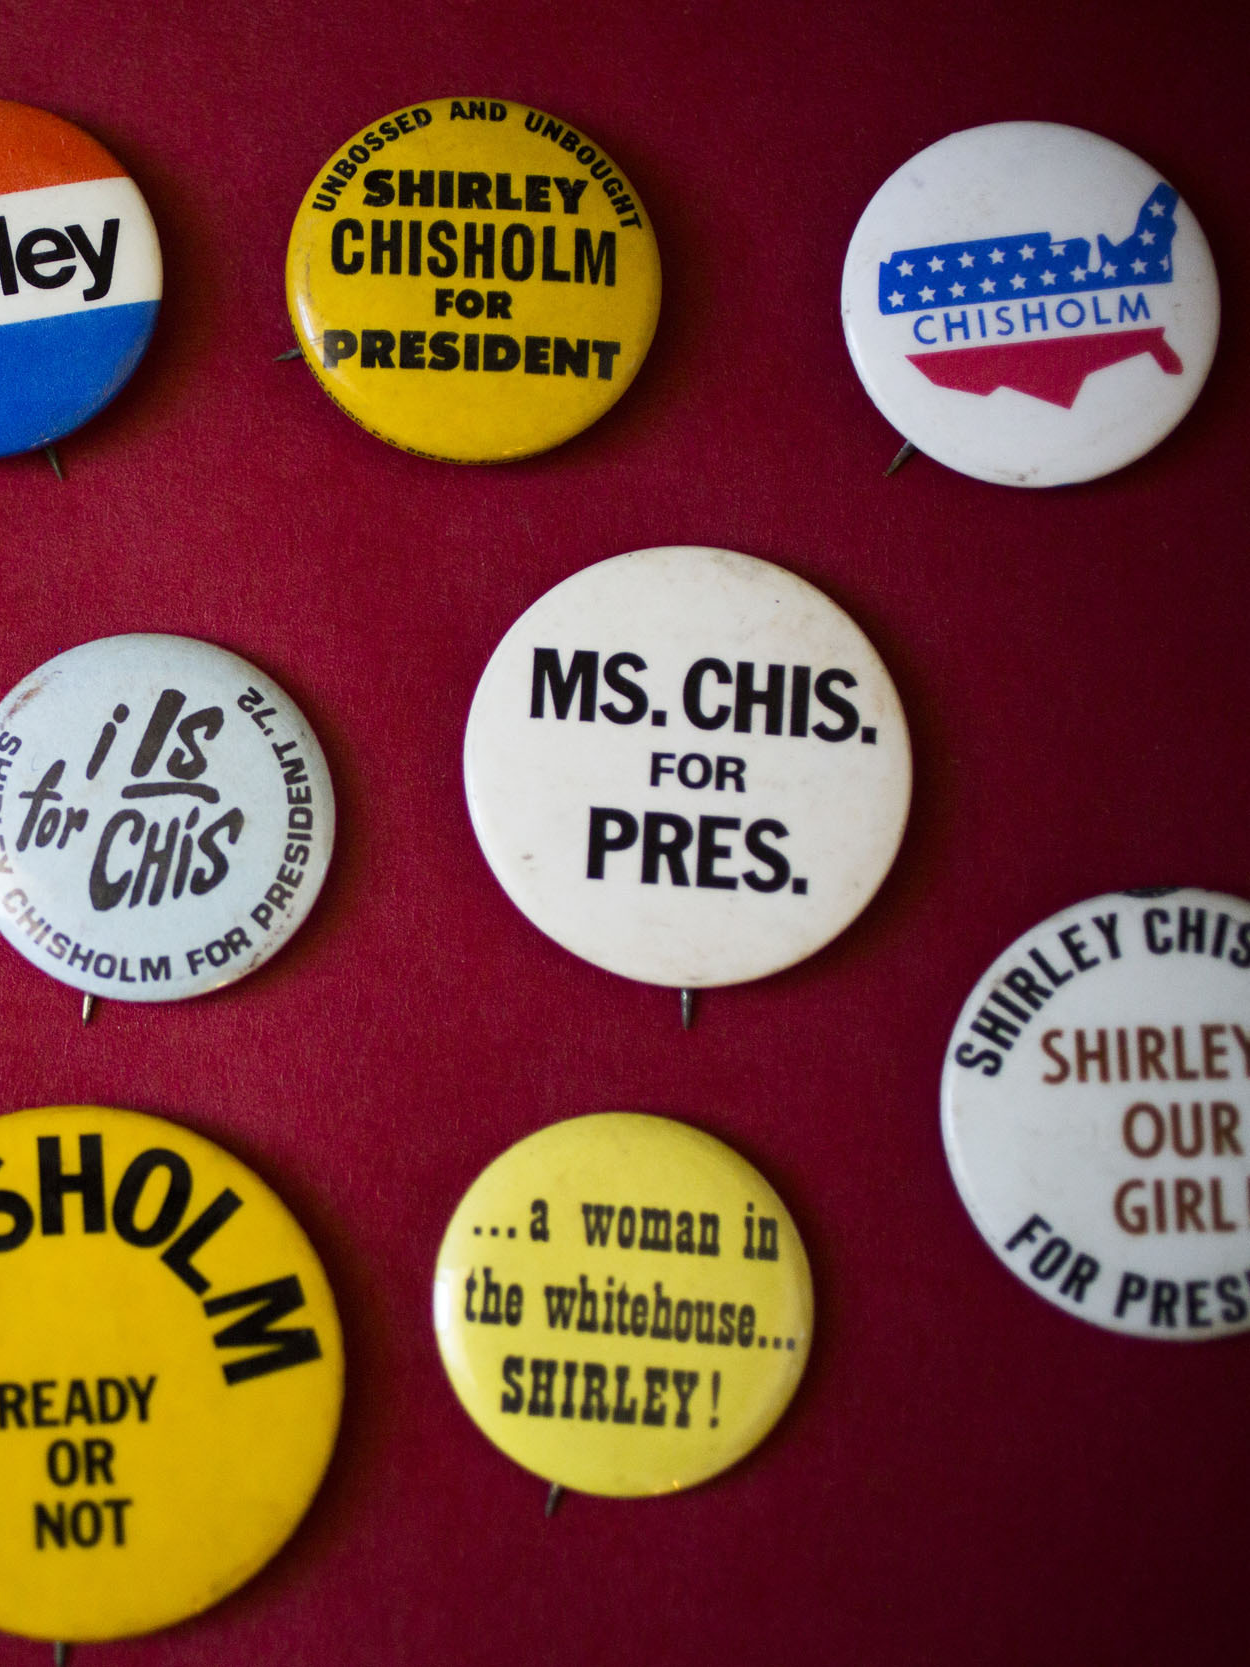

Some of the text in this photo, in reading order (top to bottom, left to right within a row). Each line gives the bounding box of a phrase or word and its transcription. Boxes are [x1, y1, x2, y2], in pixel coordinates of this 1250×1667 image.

[312, 100, 643, 231] UNBOSSED AND UNBOUGHT
[362, 169, 589, 215] SHIRLEY
[330, 218, 617, 288] CHISHOLM
[434, 288, 513, 320] FOR
[913, 292, 1150, 345] CHISHOLM
[322, 329, 621, 381] PRESIDENT
[530, 647, 878, 745] MS. CHIS.
[86, 703, 130, 780] i
[650, 752, 747, 793] FOR
[15, 760, 88, 852] for
[2, 887, 172, 983] CHISHOLM
[186, 926, 252, 975] FOR
[250, 740, 313, 930] PRESIDENT
[586, 806, 808, 895] PRES.
[955, 912, 1121, 1077] SHIRLEY
[1041, 1024, 1250, 1084] SHIRLEY
[1122, 1101, 1244, 1159] OUR
[582, 1202, 719, 1257] woman
[742, 1202, 779, 1261] in
[1114, 1177, 1250, 1236] GIRL
[1005, 1213, 1250, 1328] FOR PRES
[464, 1266, 796, 1351] the whitehouse...
[45, 1438, 116, 1488] OR
[33, 1498, 134, 1551] NOT
